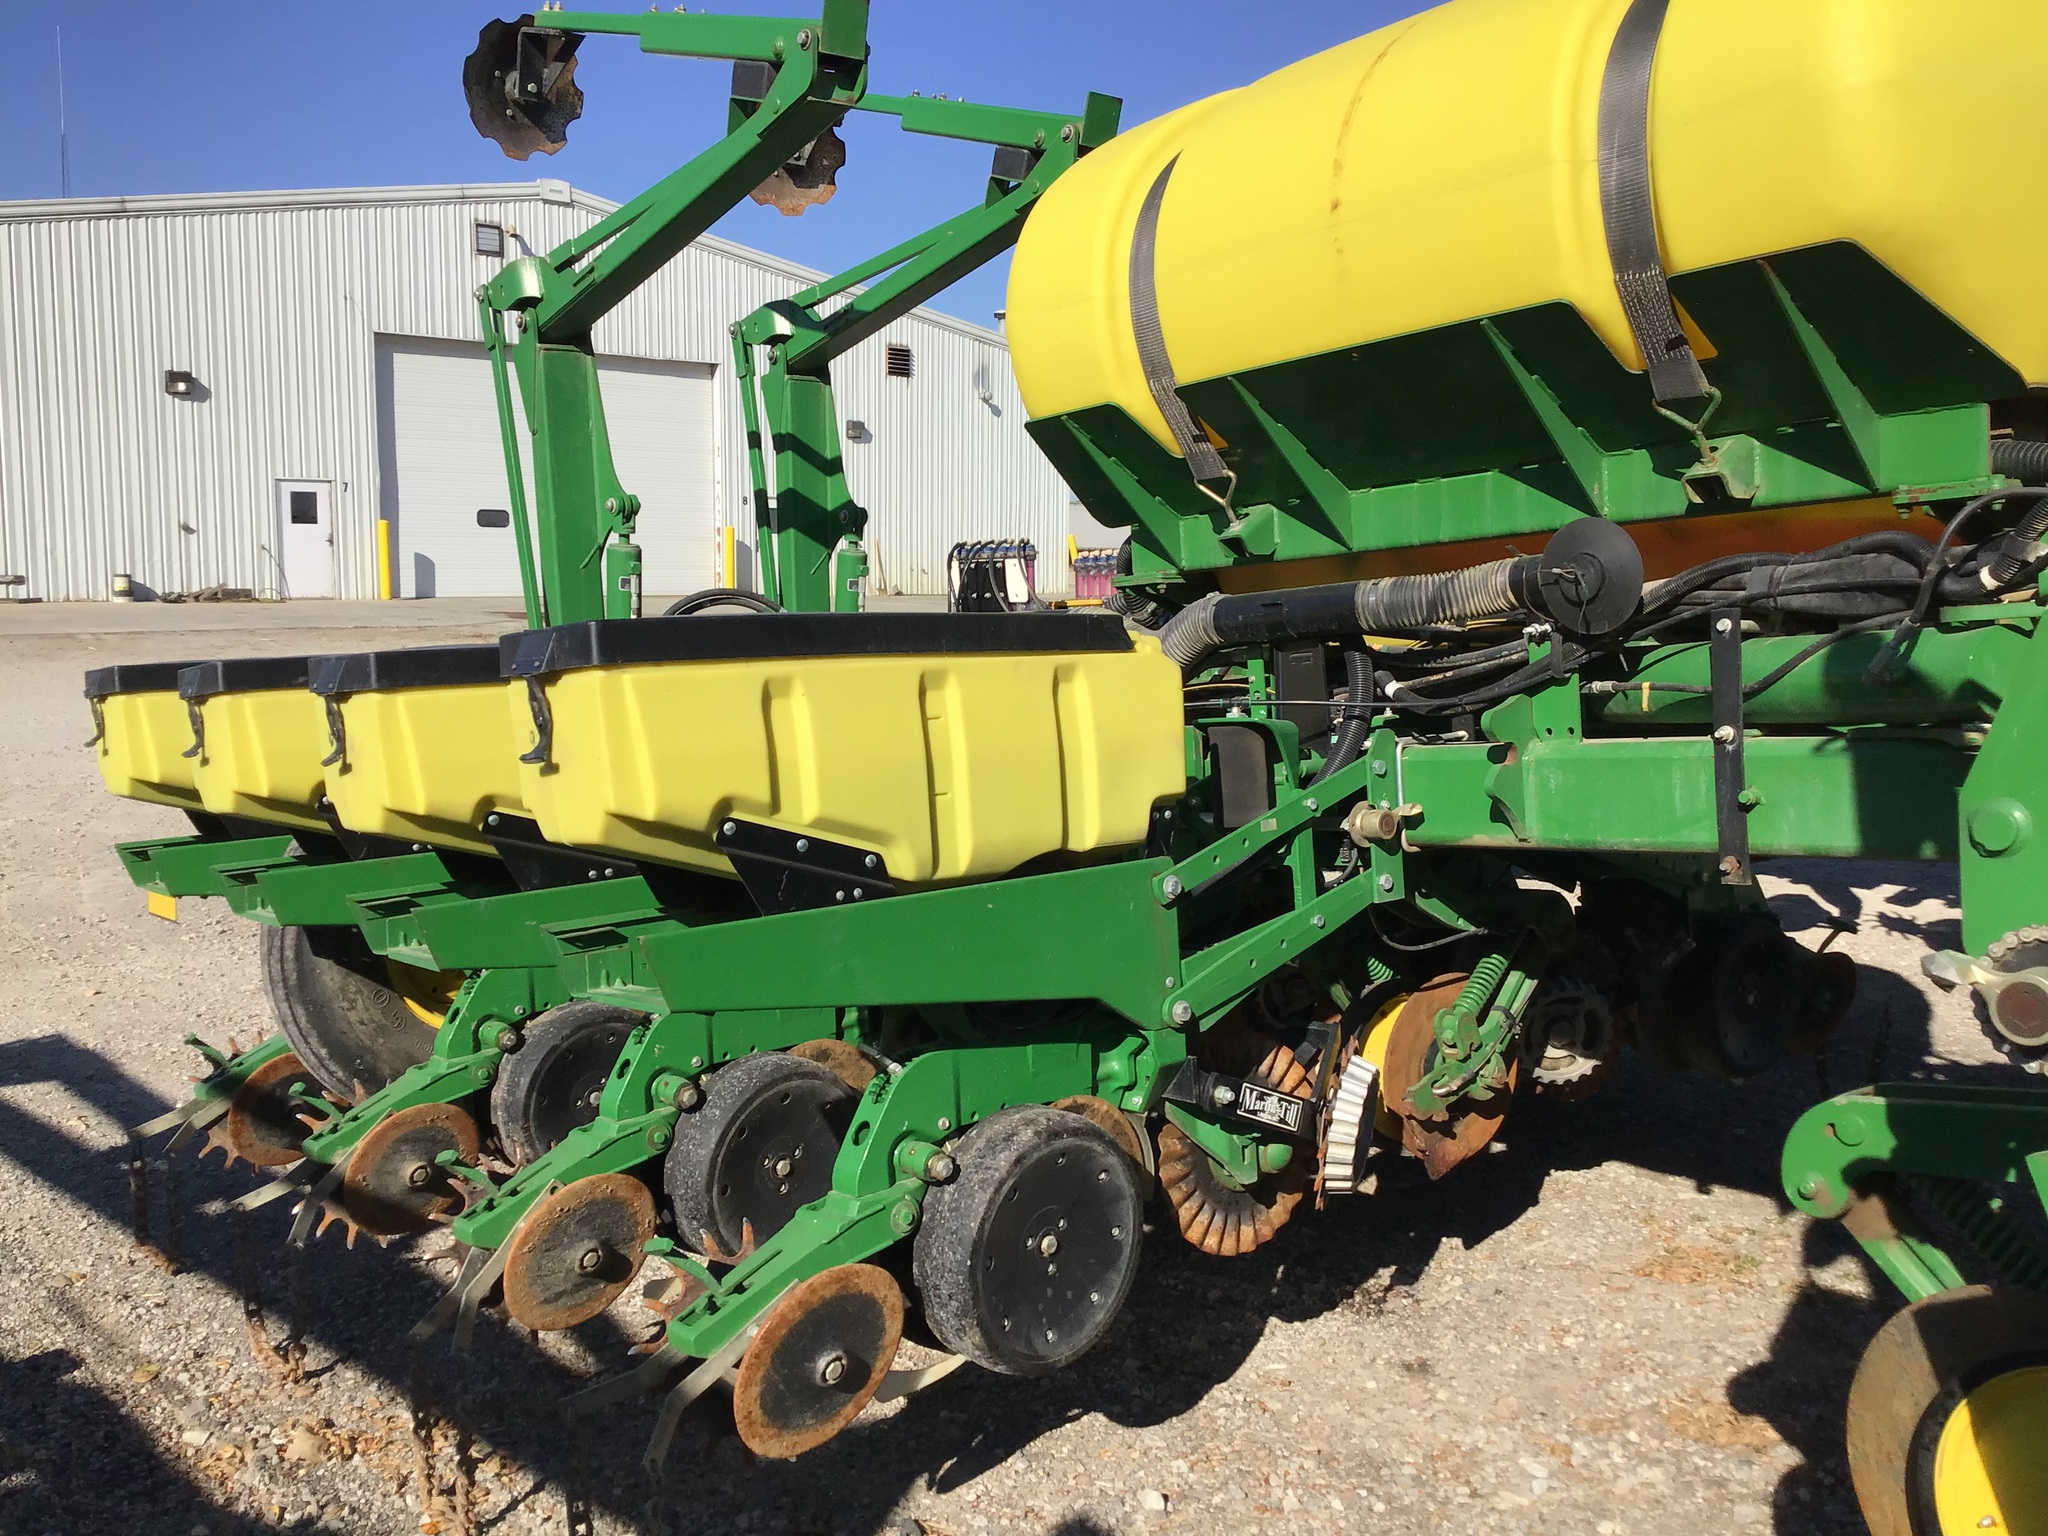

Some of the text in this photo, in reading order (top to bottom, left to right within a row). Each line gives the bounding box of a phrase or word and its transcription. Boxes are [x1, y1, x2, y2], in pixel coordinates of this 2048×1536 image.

[342, 481, 349, 493] 7
[742, 495, 748, 506] 8
[1280, 1101, 1298, 1127] Till
